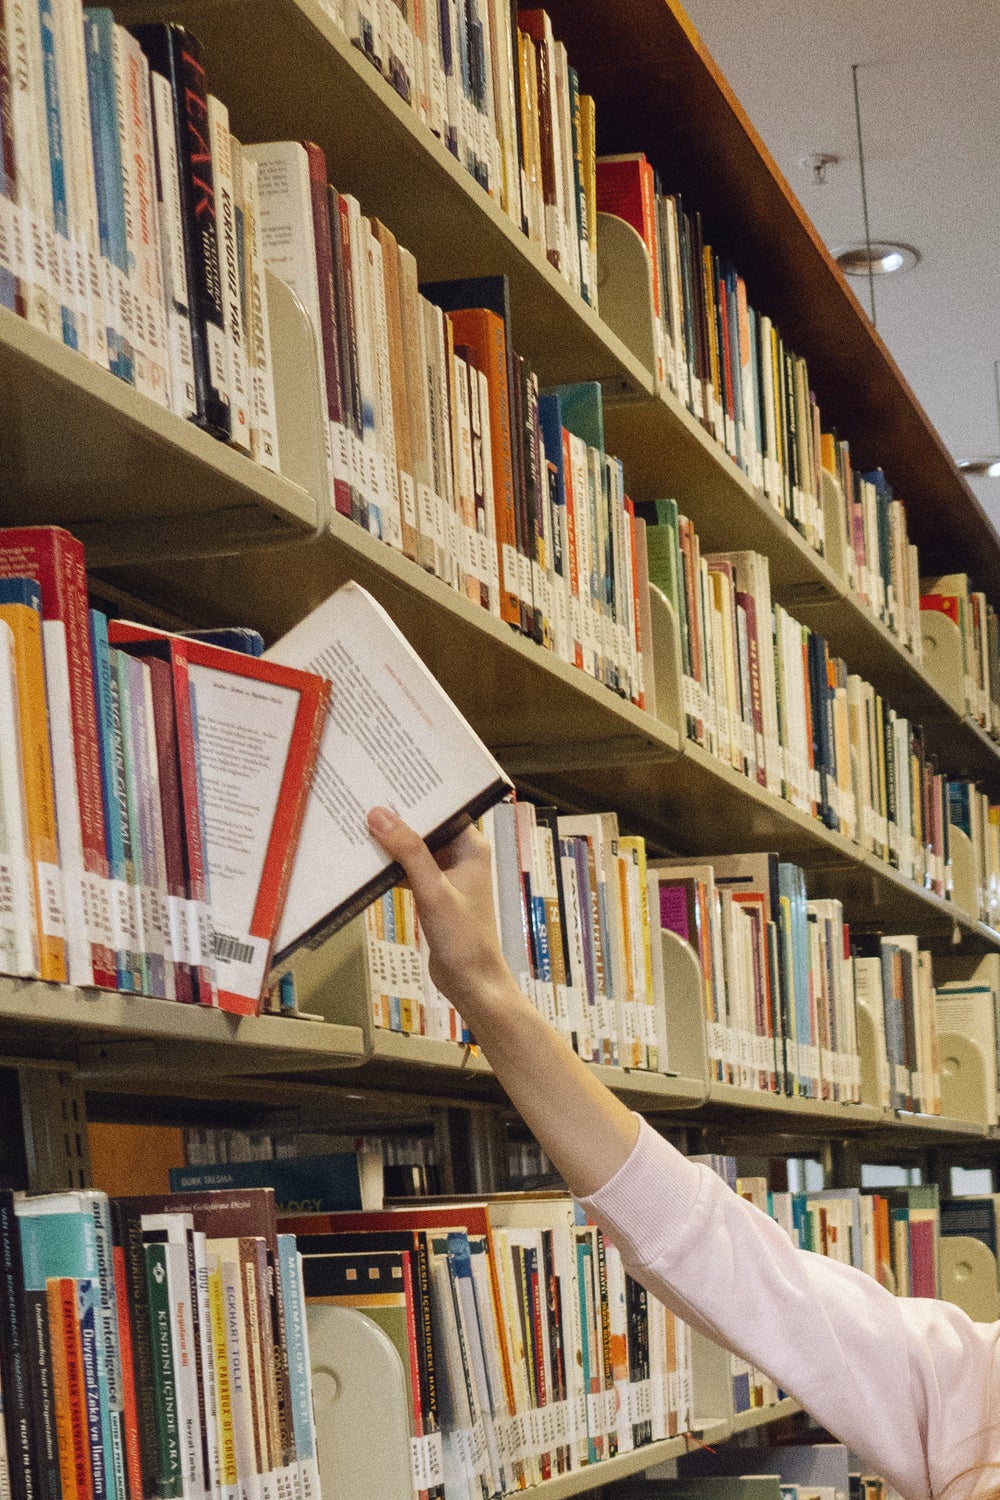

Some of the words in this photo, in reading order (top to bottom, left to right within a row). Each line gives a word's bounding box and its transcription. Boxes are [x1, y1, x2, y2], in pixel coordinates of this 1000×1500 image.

[179, 49, 219, 218] FEAR
[201, 230, 214, 298] HISTORY
[220, 187, 238, 296] KORKUSUZ
[65, 552, 74, 580] The
[76, 562, 85, 590] The
[67, 584, 79, 645] Science
[78, 595, 90, 653] Science
[71, 648, 80, 665] of
[83, 659, 91, 673] of
[73, 668, 85, 731] Intimate
[84, 675, 96, 740] Intimate
[77, 734, 93, 834] Relationships
[88, 742, 104, 841] Relationships
[92, 1201, 103, 1228] and
[95, 1235, 112, 1310] emotional
[156, 1309, 172, 1375] KENDİNİ
[226, 1285, 238, 1343] ECKHART
[287, 1257, 304, 1374] MARSHMALLOW
[100, 1315, 119, 1404] intelligence
[216, 1343, 226, 1359] THE
[231, 1350, 242, 1393] TOLLE
[81, 1328, 97, 1388] Duygusal
[91, 1425, 98, 1441] ve
[161, 1379, 177, 1433] İÇİNDE
[217, 1365, 230, 1415] PARADOX
[428, 1375, 436, 1410] HAYAT
[167, 1437, 179, 1470] ARA
[222, 1420, 232, 1435] OF
[223, 1438, 235, 1477] CHOICE
